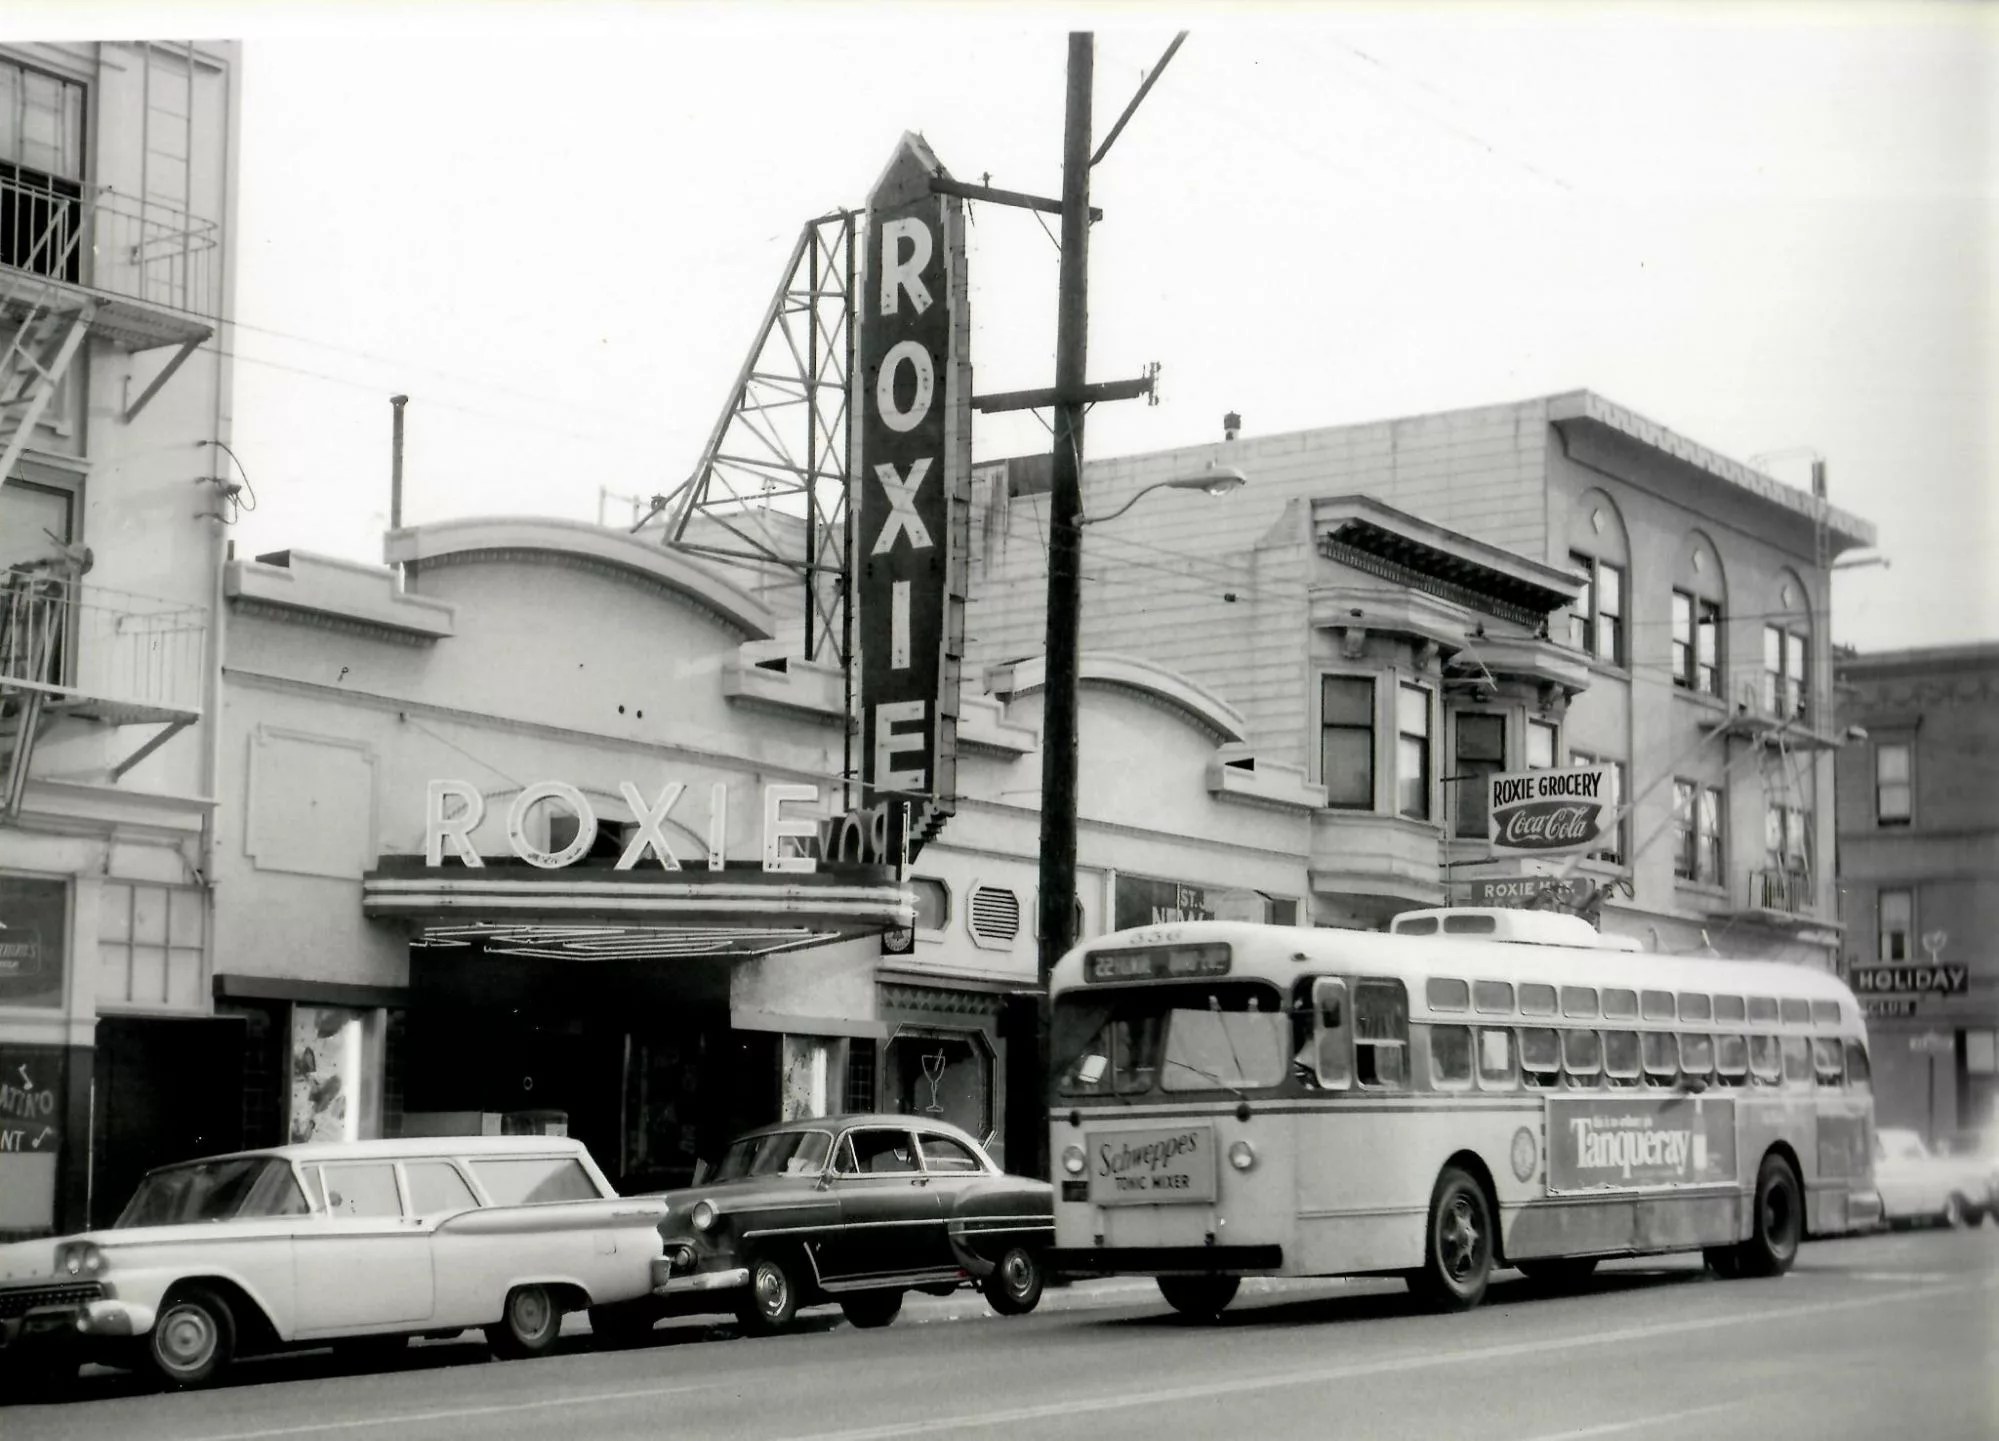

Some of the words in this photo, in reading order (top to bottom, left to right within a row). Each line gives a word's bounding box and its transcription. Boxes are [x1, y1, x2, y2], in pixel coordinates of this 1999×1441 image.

[872, 216, 935, 793] ROXIE
[1493, 777, 1535, 808] ROXIE
[1538, 772, 1602, 797] GROCERY
[426, 779, 819, 873] ROXIE
[1484, 882, 1535, 898] ROXIE
[1859, 967, 1965, 991] HOLIDAY
[1099, 1132, 1198, 1177] Schweppes
[1570, 1117, 1691, 1179] Tanqueray
[1115, 1176, 1146, 1190] TONIC
[1152, 1174, 1190, 1189] MIXER
